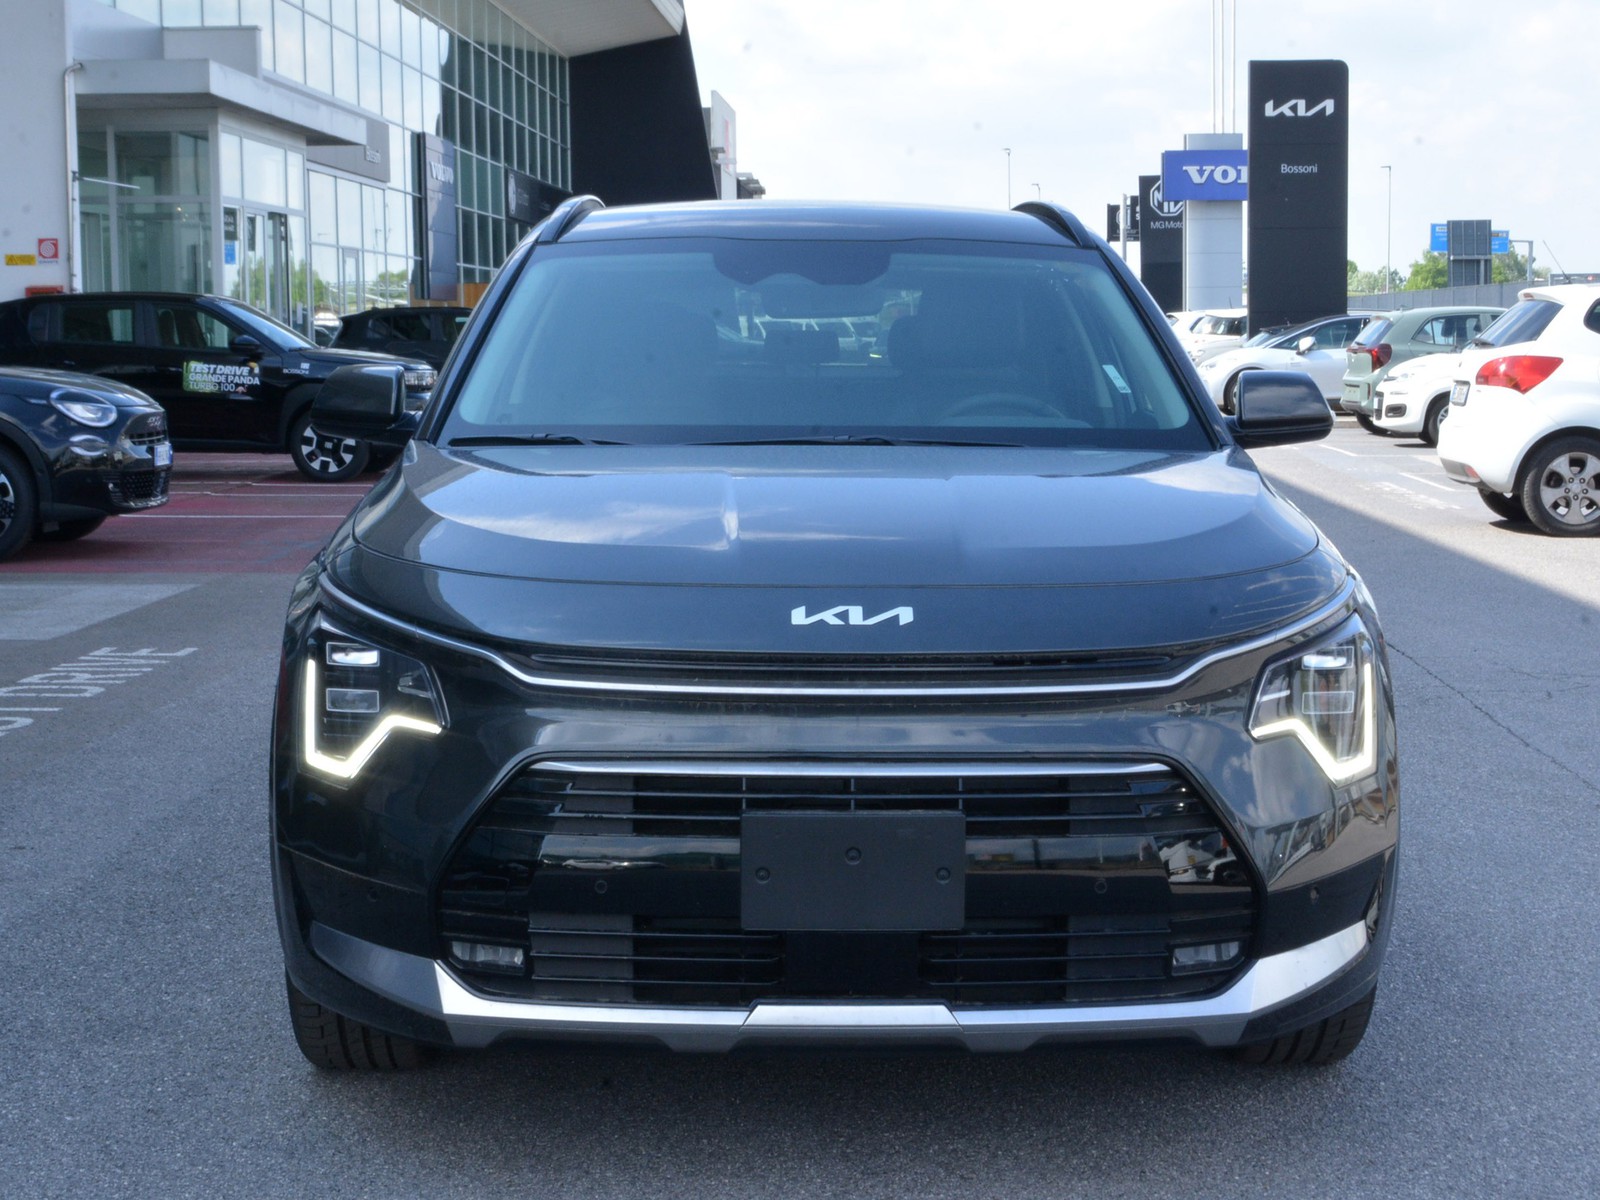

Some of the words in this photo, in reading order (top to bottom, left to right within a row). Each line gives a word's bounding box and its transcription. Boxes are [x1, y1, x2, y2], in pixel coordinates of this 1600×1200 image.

[1265, 98, 1334, 117] KIA
[1280, 163, 1319, 174] Bossoni
[1150, 221, 1165, 229] MG
[190, 363, 216, 374] TEST
[216, 365, 250, 376] DRIVE
[189, 373, 227, 383] GRANDE
[228, 375, 260, 385] PANDA
[189, 381, 219, 391] TURBO
[221, 383, 236, 392] 100
[791, 605, 914, 626] KIA
[0, 647, 199, 698] DRIVE
